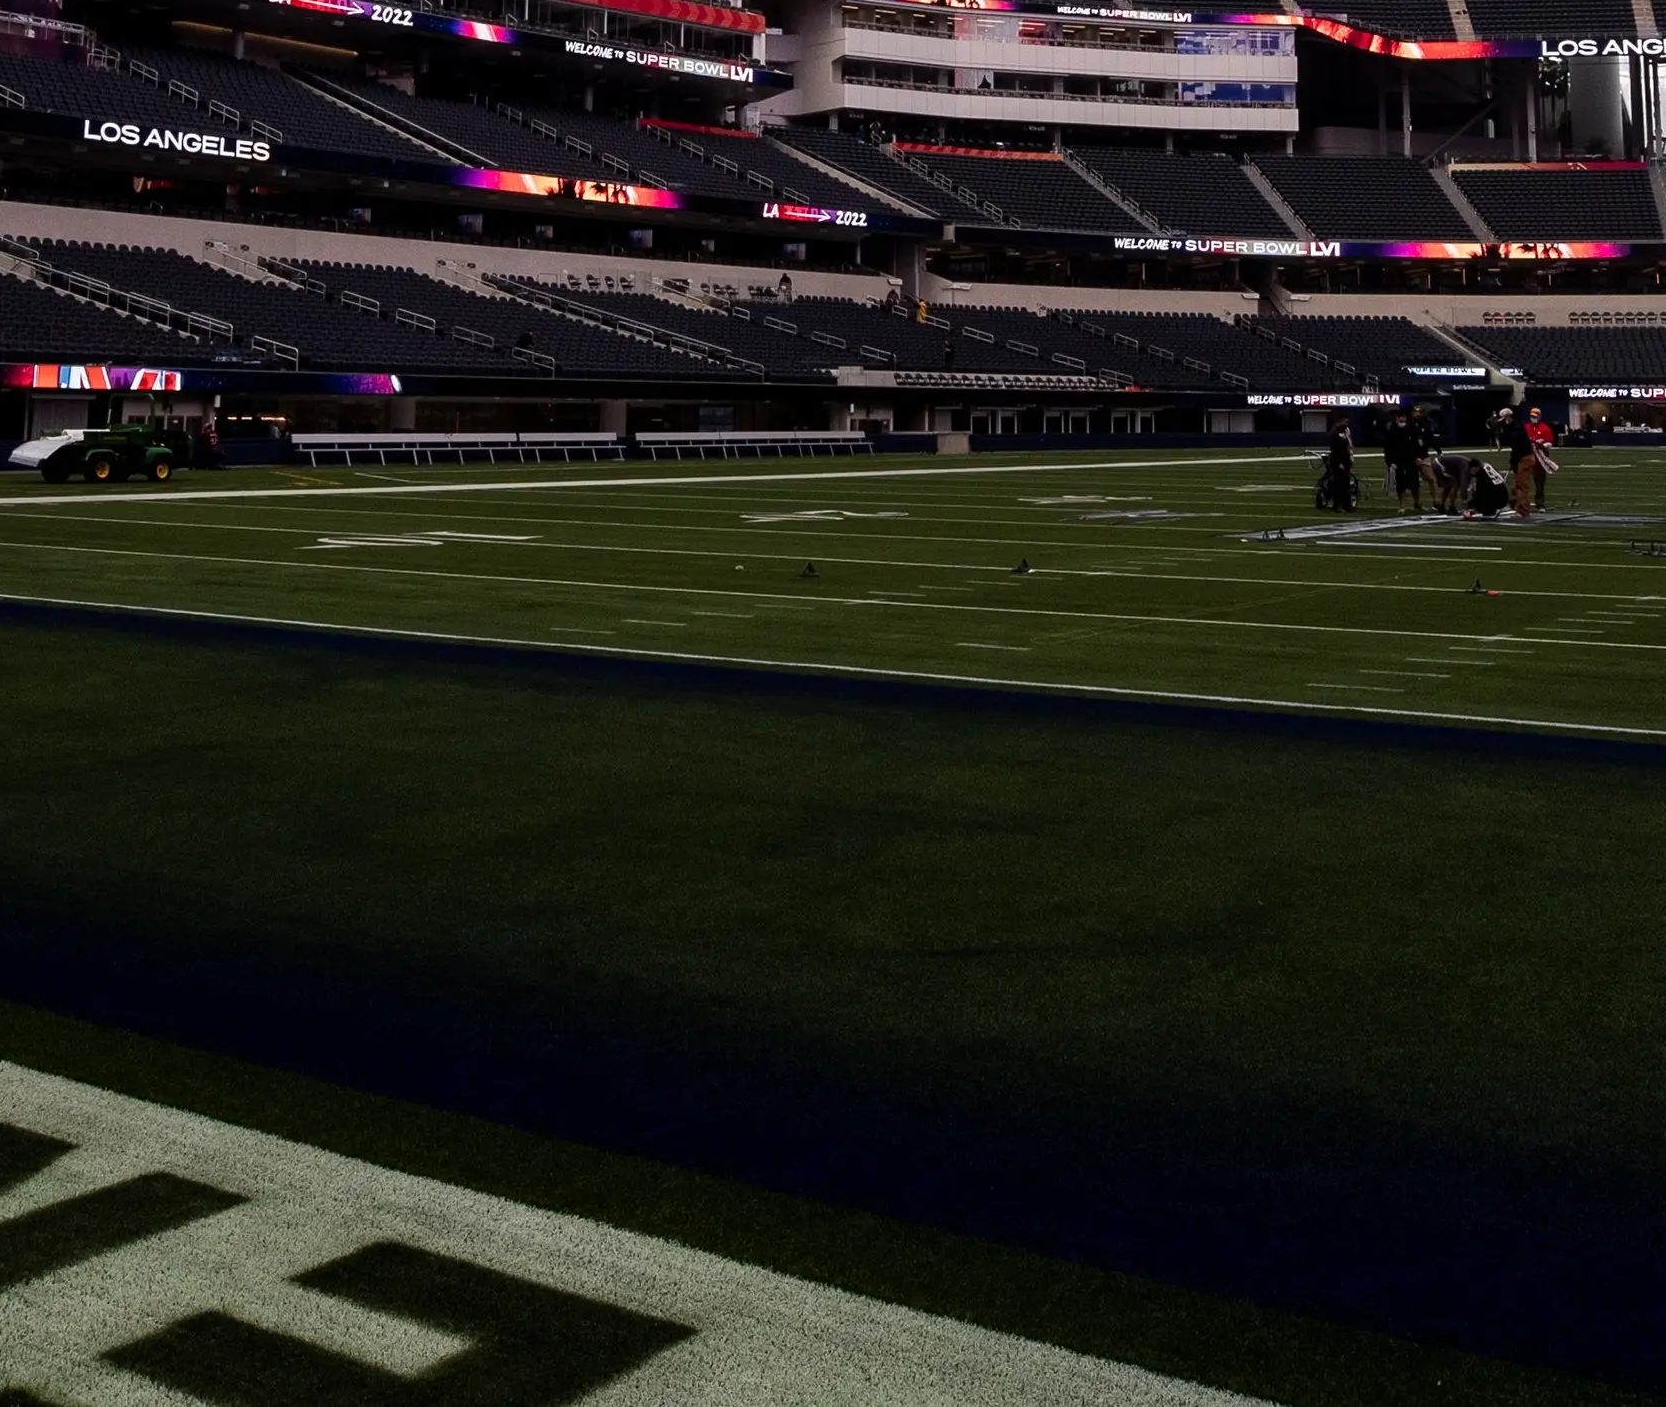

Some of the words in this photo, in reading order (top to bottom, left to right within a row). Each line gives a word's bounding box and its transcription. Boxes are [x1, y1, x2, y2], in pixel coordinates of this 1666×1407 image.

[371, 4, 414, 27] 2022
[1057, 5, 1091, 15] WELCOME
[1099, 8, 1138, 19] SUPER
[1139, 10, 1173, 21] BOWL
[1173, 12, 1192, 23] LVI
[1542, 38, 1601, 57] LOS
[565, 40, 613, 61] WELCOME
[625, 51, 680, 71] SUPER
[683, 57, 729, 80] BOWL
[730, 64, 754, 83] LVI
[83, 119, 141, 146] LOS
[142, 128, 271, 162] ANGELES
[763, 202, 779, 219] LA
[836, 210, 867, 228] 2022
[1114, 237, 1170, 251] WELCOME
[1184, 239, 1248, 253] SUPER
[1253, 241, 1307, 256] BOWL
[1309, 241, 1340, 256] LVI
[1247, 395, 1284, 405] WELCOME
[1293, 395, 1337, 405] SUPER
[1569, 388, 1617, 398] WELCOME
